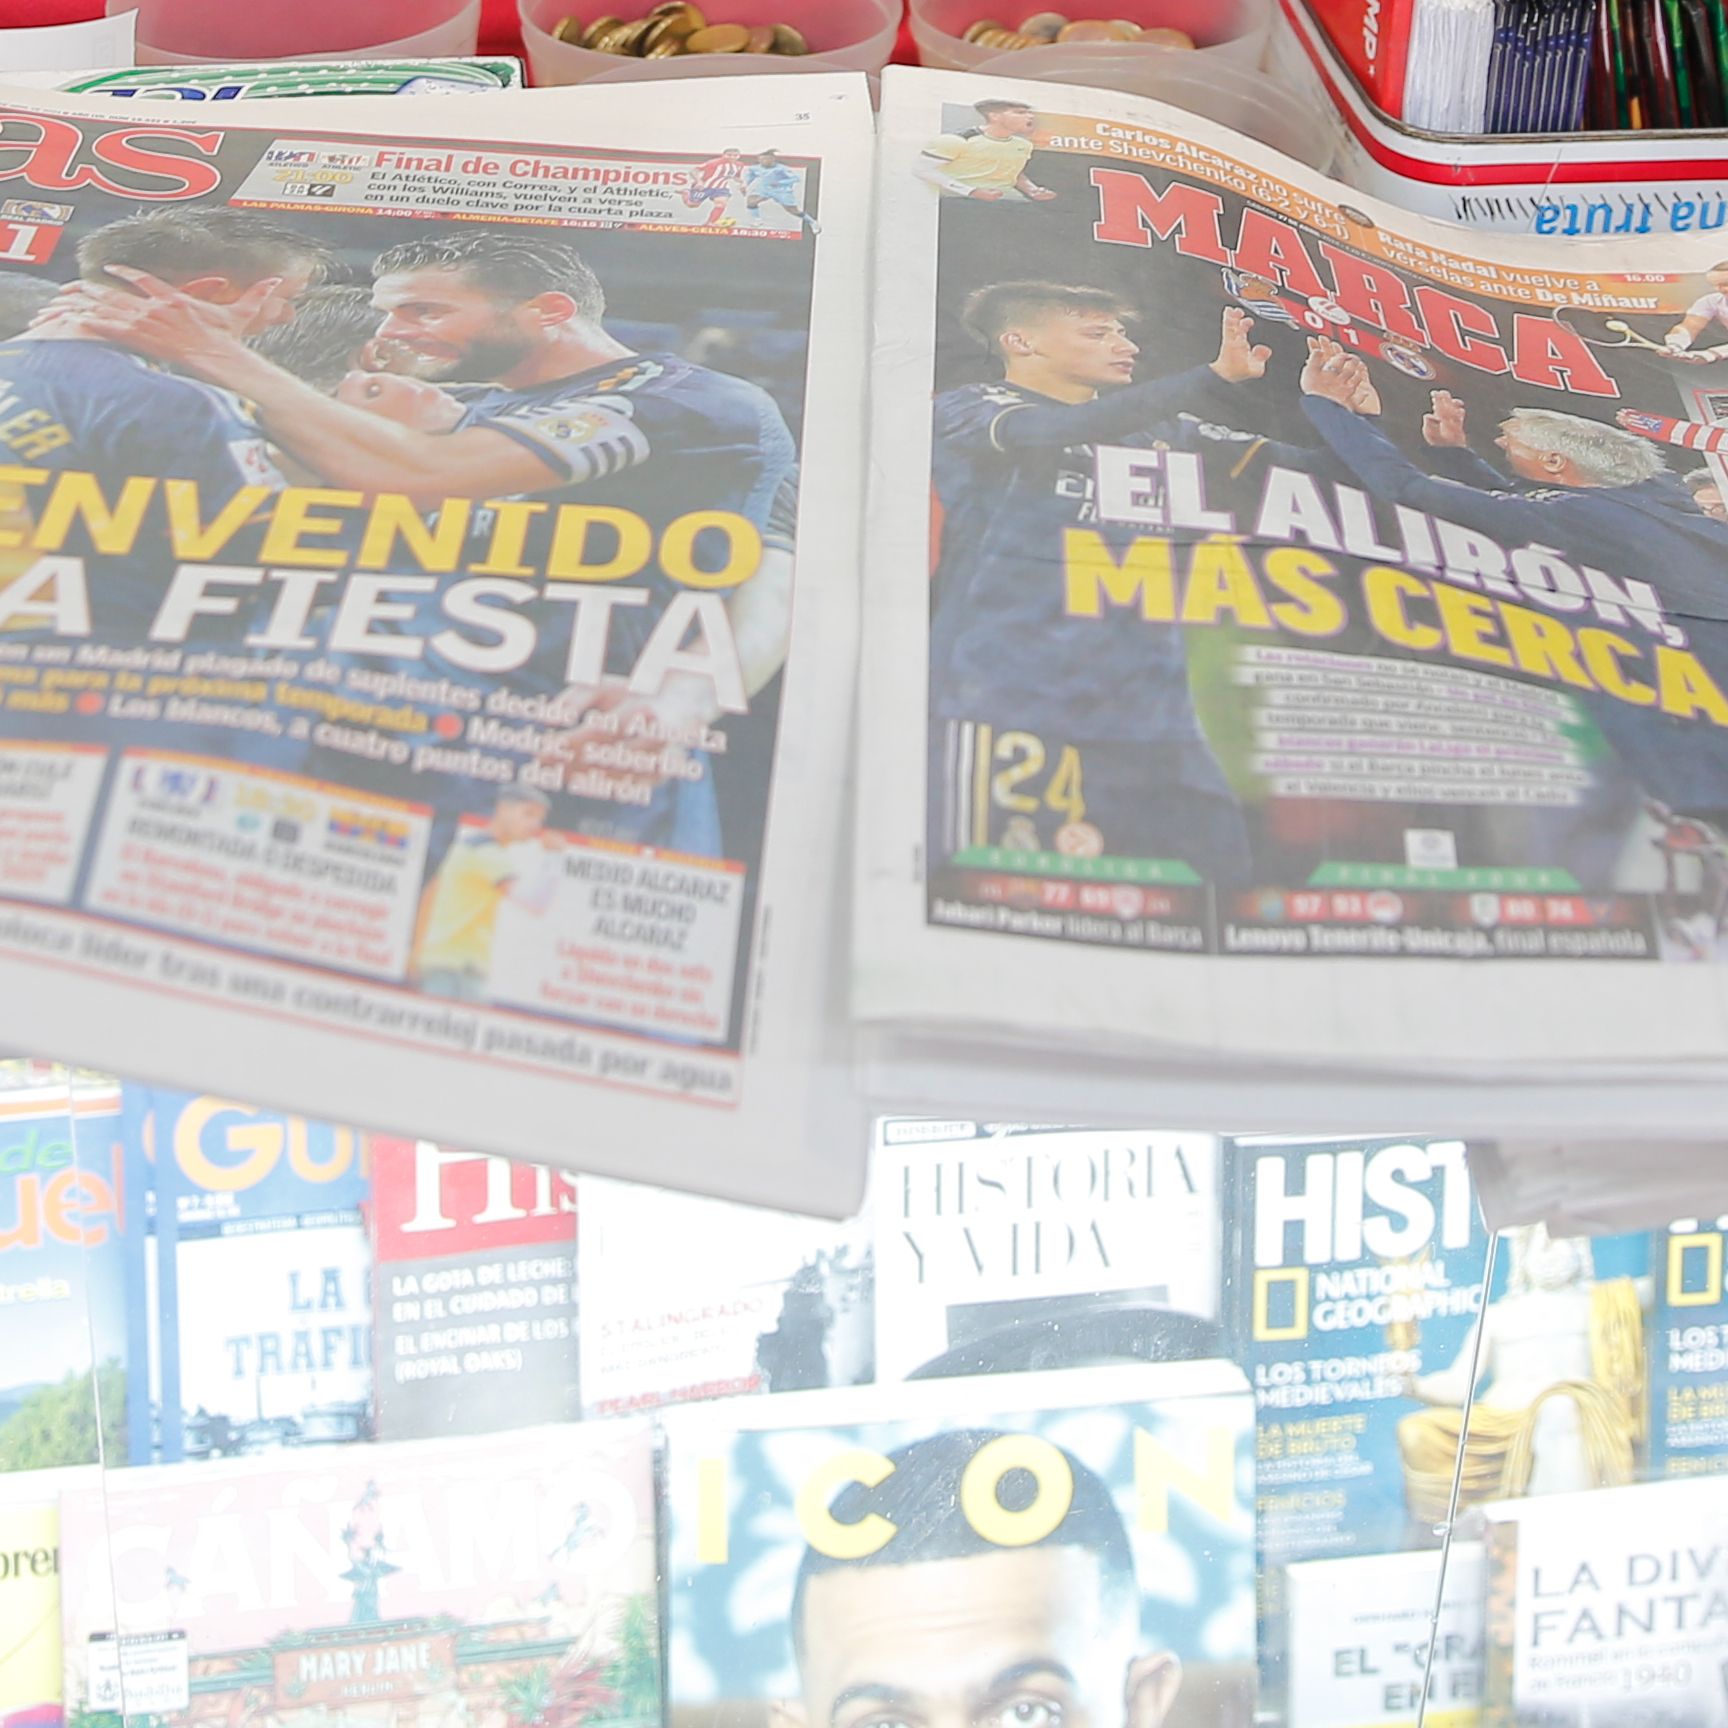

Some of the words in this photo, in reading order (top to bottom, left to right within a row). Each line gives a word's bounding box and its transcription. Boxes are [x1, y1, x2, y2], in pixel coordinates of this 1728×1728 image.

[374, 150, 455, 175] Final
[461, 154, 502, 176] de
[508, 158, 692, 188] Champions
[389, 173, 464, 189] Atlético,
[503, 179, 563, 194] Correa,
[601, 184, 674, 200] Athletic,
[1049, 134, 1103, 151] ante
[1108, 139, 1247, 192] Shevchenko
[1096, 122, 1172, 149] Carlos
[1175, 141, 1259, 183] Alcaraz
[1292, 188, 1347, 225] sufre
[414, 194, 462, 207] duelo
[465, 196, 509, 210] clave
[431, 185, 508, 202] Williams,
[513, 189, 575, 203] vuelven
[596, 196, 644, 207] verse
[1088, 166, 1623, 399] MARCA
[1376, 228, 1428, 265] Rafa
[1430, 245, 1498, 280] Nadal
[1503, 267, 1574, 291] vuelve
[1481, 278, 1533, 300] ante
[1570, 289, 1658, 311] Miñaur
[1092, 444, 1232, 534] EL
[1253, 466, 1692, 649] ALIRÓN,
[1063, 526, 1349, 638] MÁS
[148, 562, 750, 715] FIESTA
[899, 1142, 1203, 1222] HISTORIA
[1252, 1140, 1474, 1267] HIST
[958, 1217, 1114, 1282] VIDA
[1312, 1286, 1486, 1331] GEOGRAPHIC
[1314, 1261, 1451, 1300] NATIONAL
[1256, 1376, 1406, 1409] MEDIEVALES
[697, 1424, 1235, 1565] ICON
[299, 1649, 363, 1683] MARY
[368, 1642, 433, 1678] JANE
